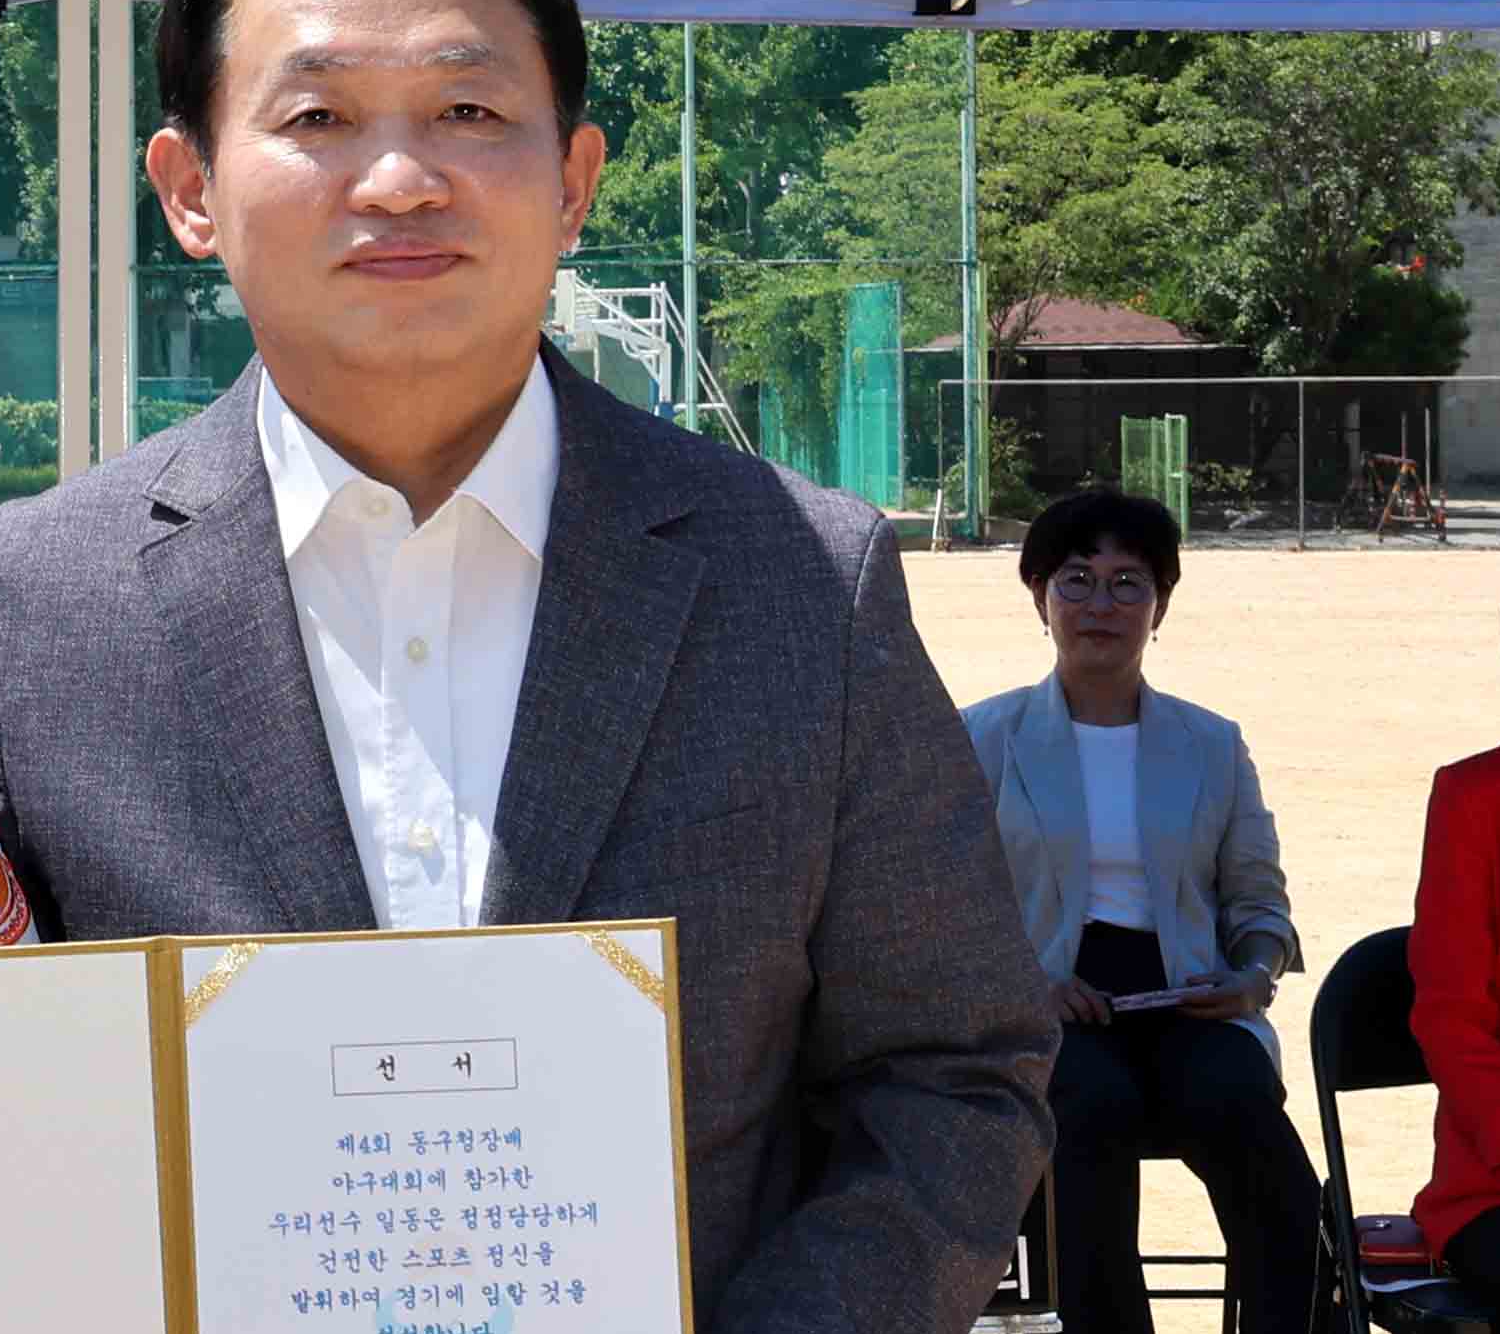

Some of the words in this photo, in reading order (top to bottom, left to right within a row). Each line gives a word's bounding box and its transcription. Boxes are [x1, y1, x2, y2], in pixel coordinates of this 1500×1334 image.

[336, 1131, 392, 1159] 제4회
[407, 1127, 523, 1157] 동구청장배
[332, 1167, 447, 1196] 야구대회에
[463, 1164, 534, 1193] 참가한
[269, 1209, 363, 1239] 우리선수
[375, 1207, 446, 1234] 일동은
[460, 1200, 600, 1230] 정정당당하게
[317, 1247, 389, 1275] 건전한
[401, 1246, 474, 1269] 스포츠
[486, 1240, 556, 1269] 정신을
[290, 1285, 382, 1315] 발휘하여
[395, 1282, 466, 1311] 경기에
[481, 1280, 528, 1308] 임할
[540, 1277, 588, 1306] 것을
